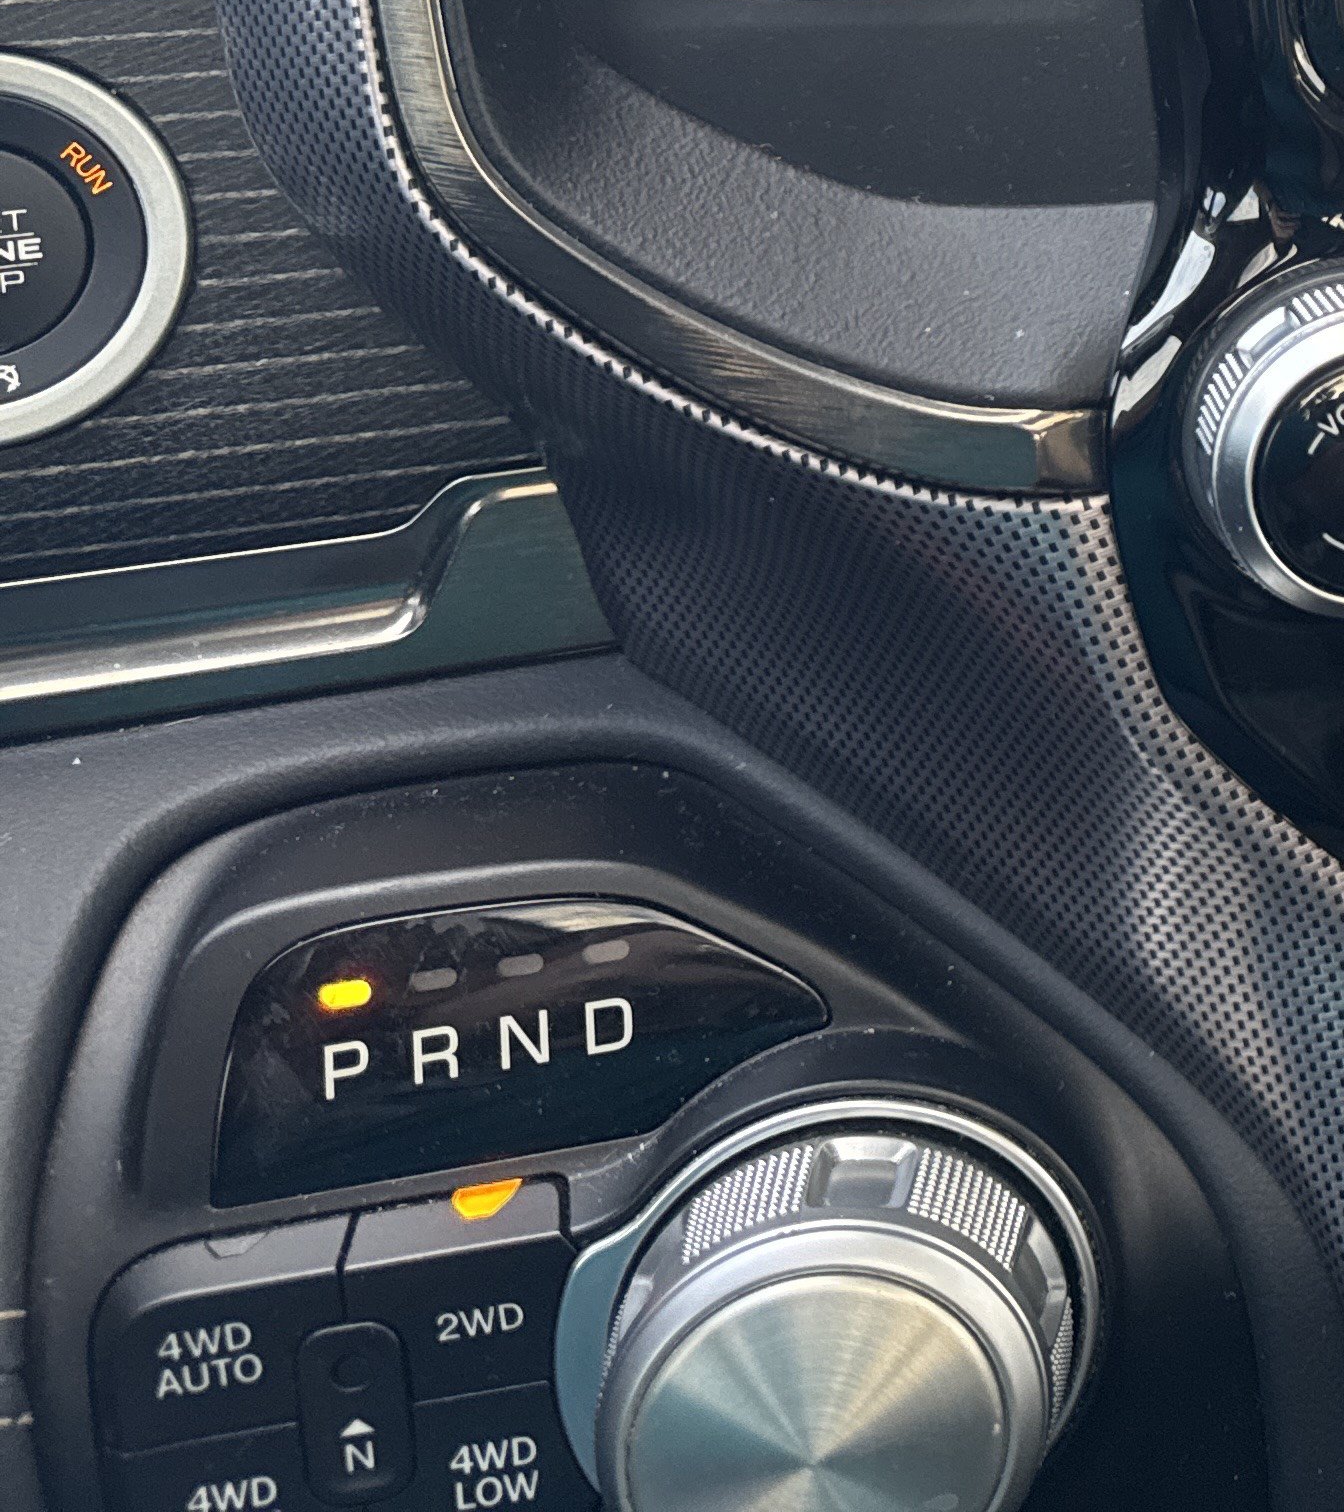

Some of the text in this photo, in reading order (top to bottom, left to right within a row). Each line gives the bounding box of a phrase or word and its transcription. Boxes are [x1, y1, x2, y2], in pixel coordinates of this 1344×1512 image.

[59, 140, 114, 196] RUN
[323, 996, 634, 1101] P R N D
[157, 1320, 252, 1362] 4WD
[437, 1302, 525, 1343] 2WD
[156, 1353, 263, 1400] AUTO
[450, 1435, 538, 1478] 4WD
[186, 1476, 278, 1512] 4WD
[454, 1470, 540, 1512] LOW
